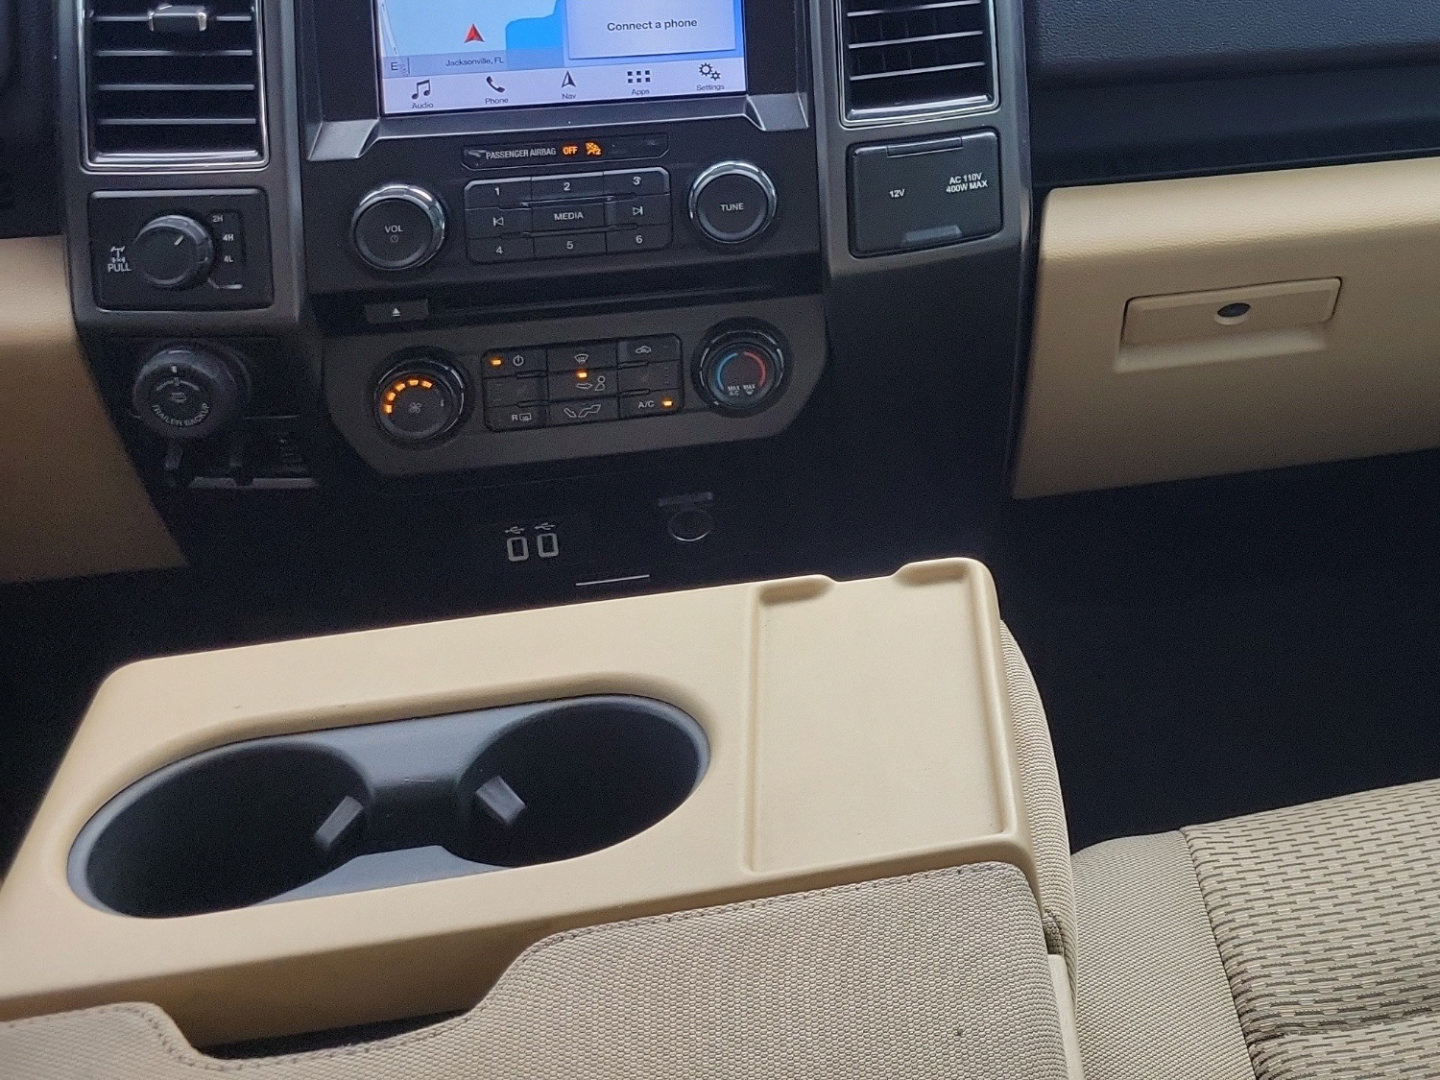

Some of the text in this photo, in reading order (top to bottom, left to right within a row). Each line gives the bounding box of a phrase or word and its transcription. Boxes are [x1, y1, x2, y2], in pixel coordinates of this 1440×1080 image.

[607, 17, 698, 32] Connect a phone
[445, 56, 504, 67] Jacksonville, FL
[631, 88, 650, 96] Apps
[696, 83, 725, 92] Settings
[484, 96, 509, 104] Phone
[561, 92, 577, 100] Nav
[412, 101, 434, 110] Audio
[485, 146, 578, 160] PASSENGER AIRBAG OFF
[632, 176, 641, 186] 3
[949, 172, 983, 184] AC 110V
[563, 182, 570, 191] 2
[946, 180, 988, 194] 400W MAX
[889, 188, 905, 198] 12V
[720, 202, 744, 212] TUNE
[554, 210, 584, 222] MEDIA
[384, 224, 403, 234] VOL
[222, 233, 234, 242] 4H
[636, 234, 643, 244] 6
[566, 240, 574, 250] 5
[496, 246, 503, 255] 4
[107, 264, 132, 272] PULL
[637, 400, 655, 409] A/C
